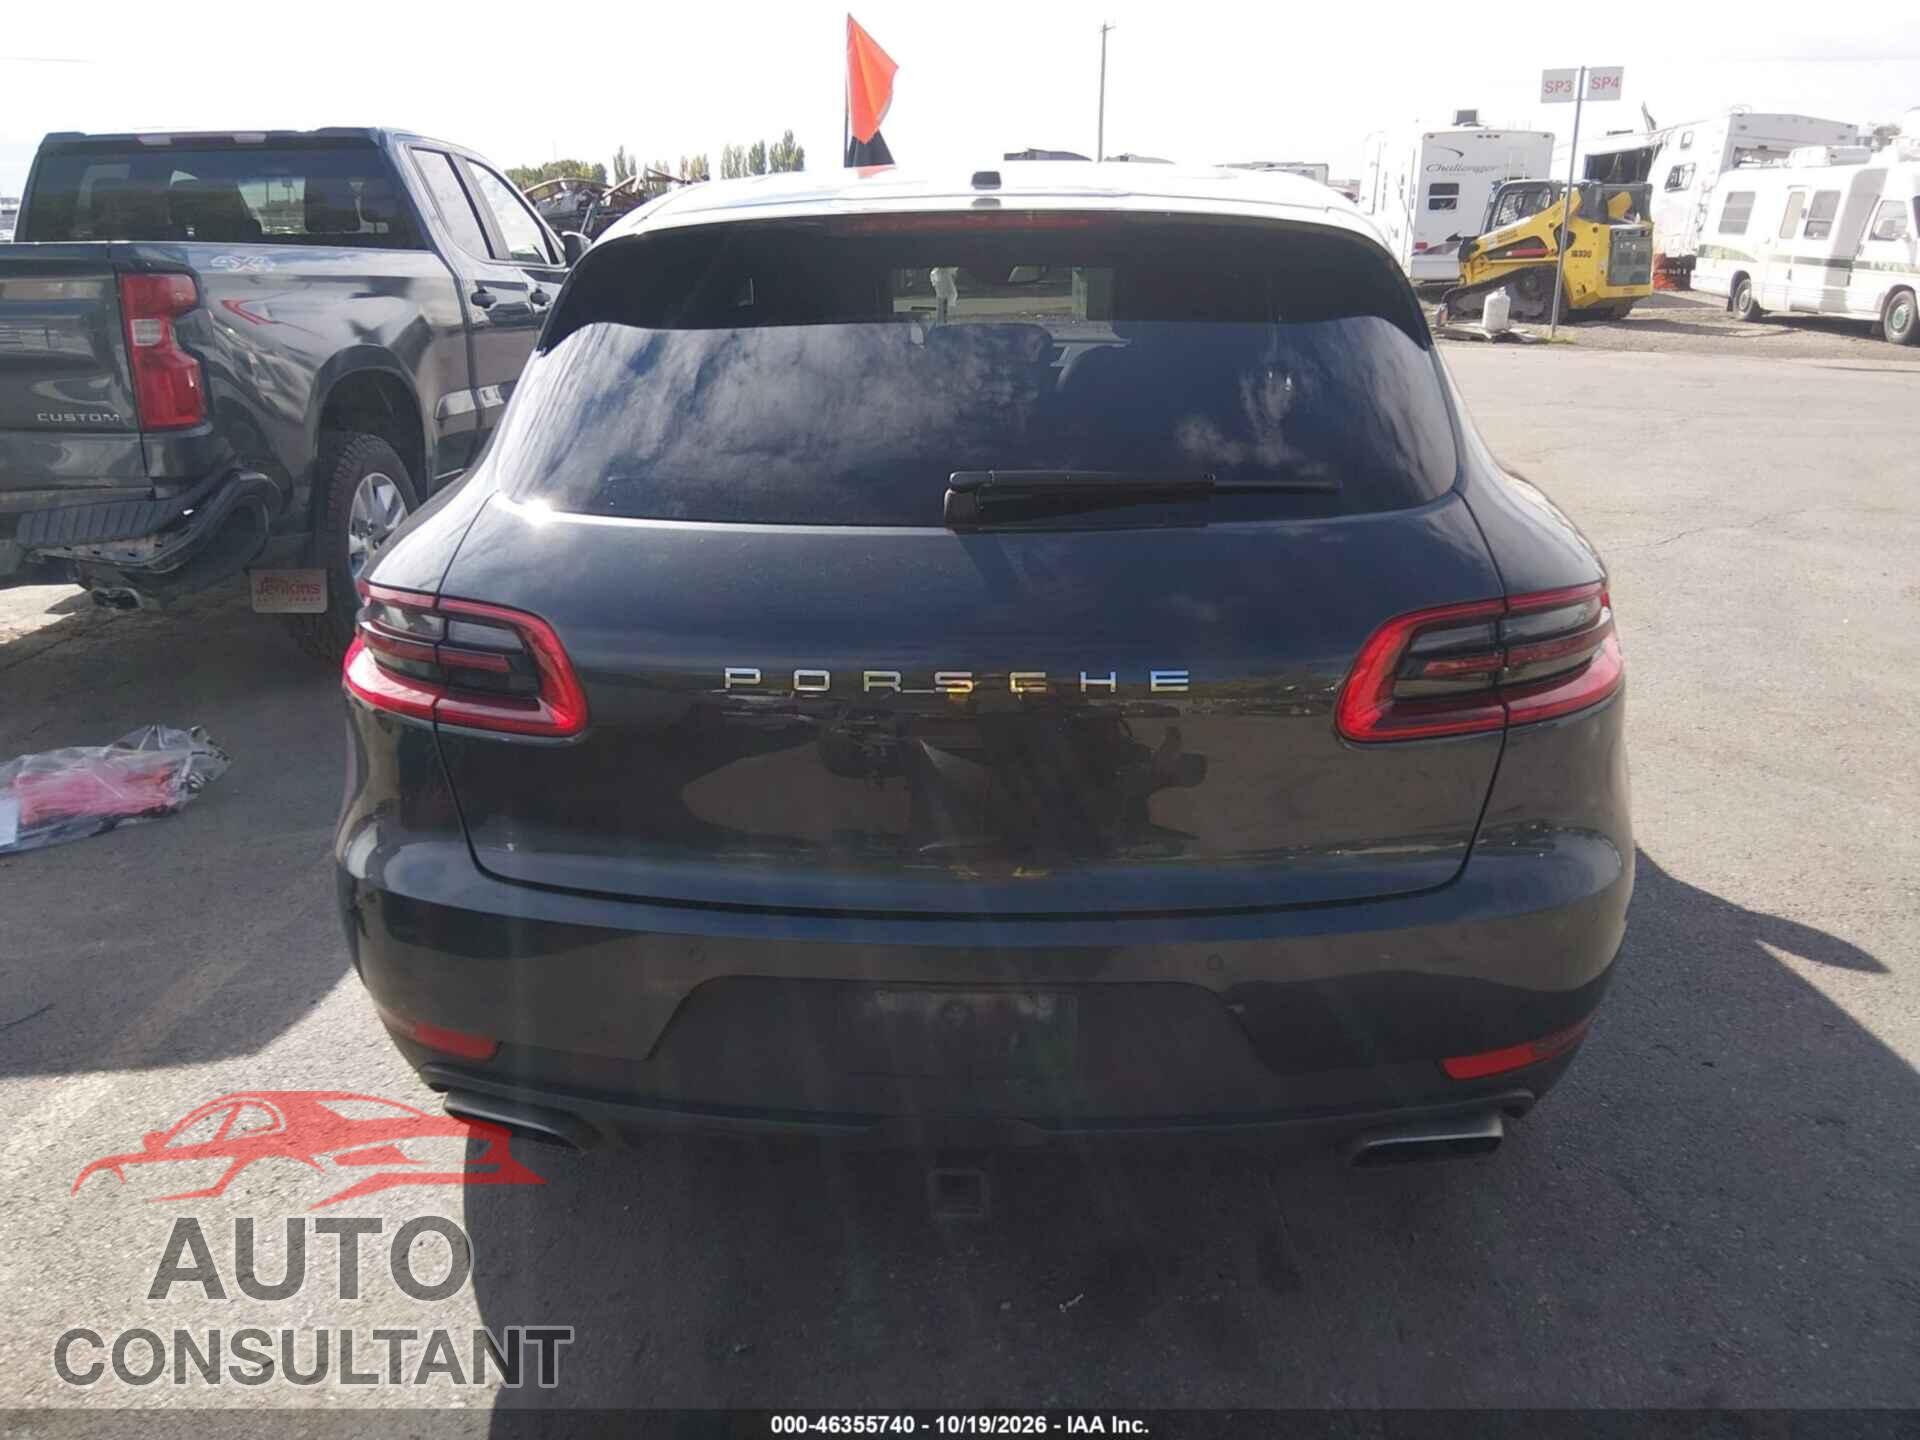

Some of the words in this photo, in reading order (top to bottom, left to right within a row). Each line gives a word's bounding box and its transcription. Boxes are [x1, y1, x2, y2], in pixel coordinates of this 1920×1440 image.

[1544, 80, 1573, 94] SP3
[1591, 76, 1620, 90] SP4
[36, 412, 121, 423] CUSTOM
[256, 579, 321, 596] Jenkins
[724, 667, 1190, 693] PORSCHE
